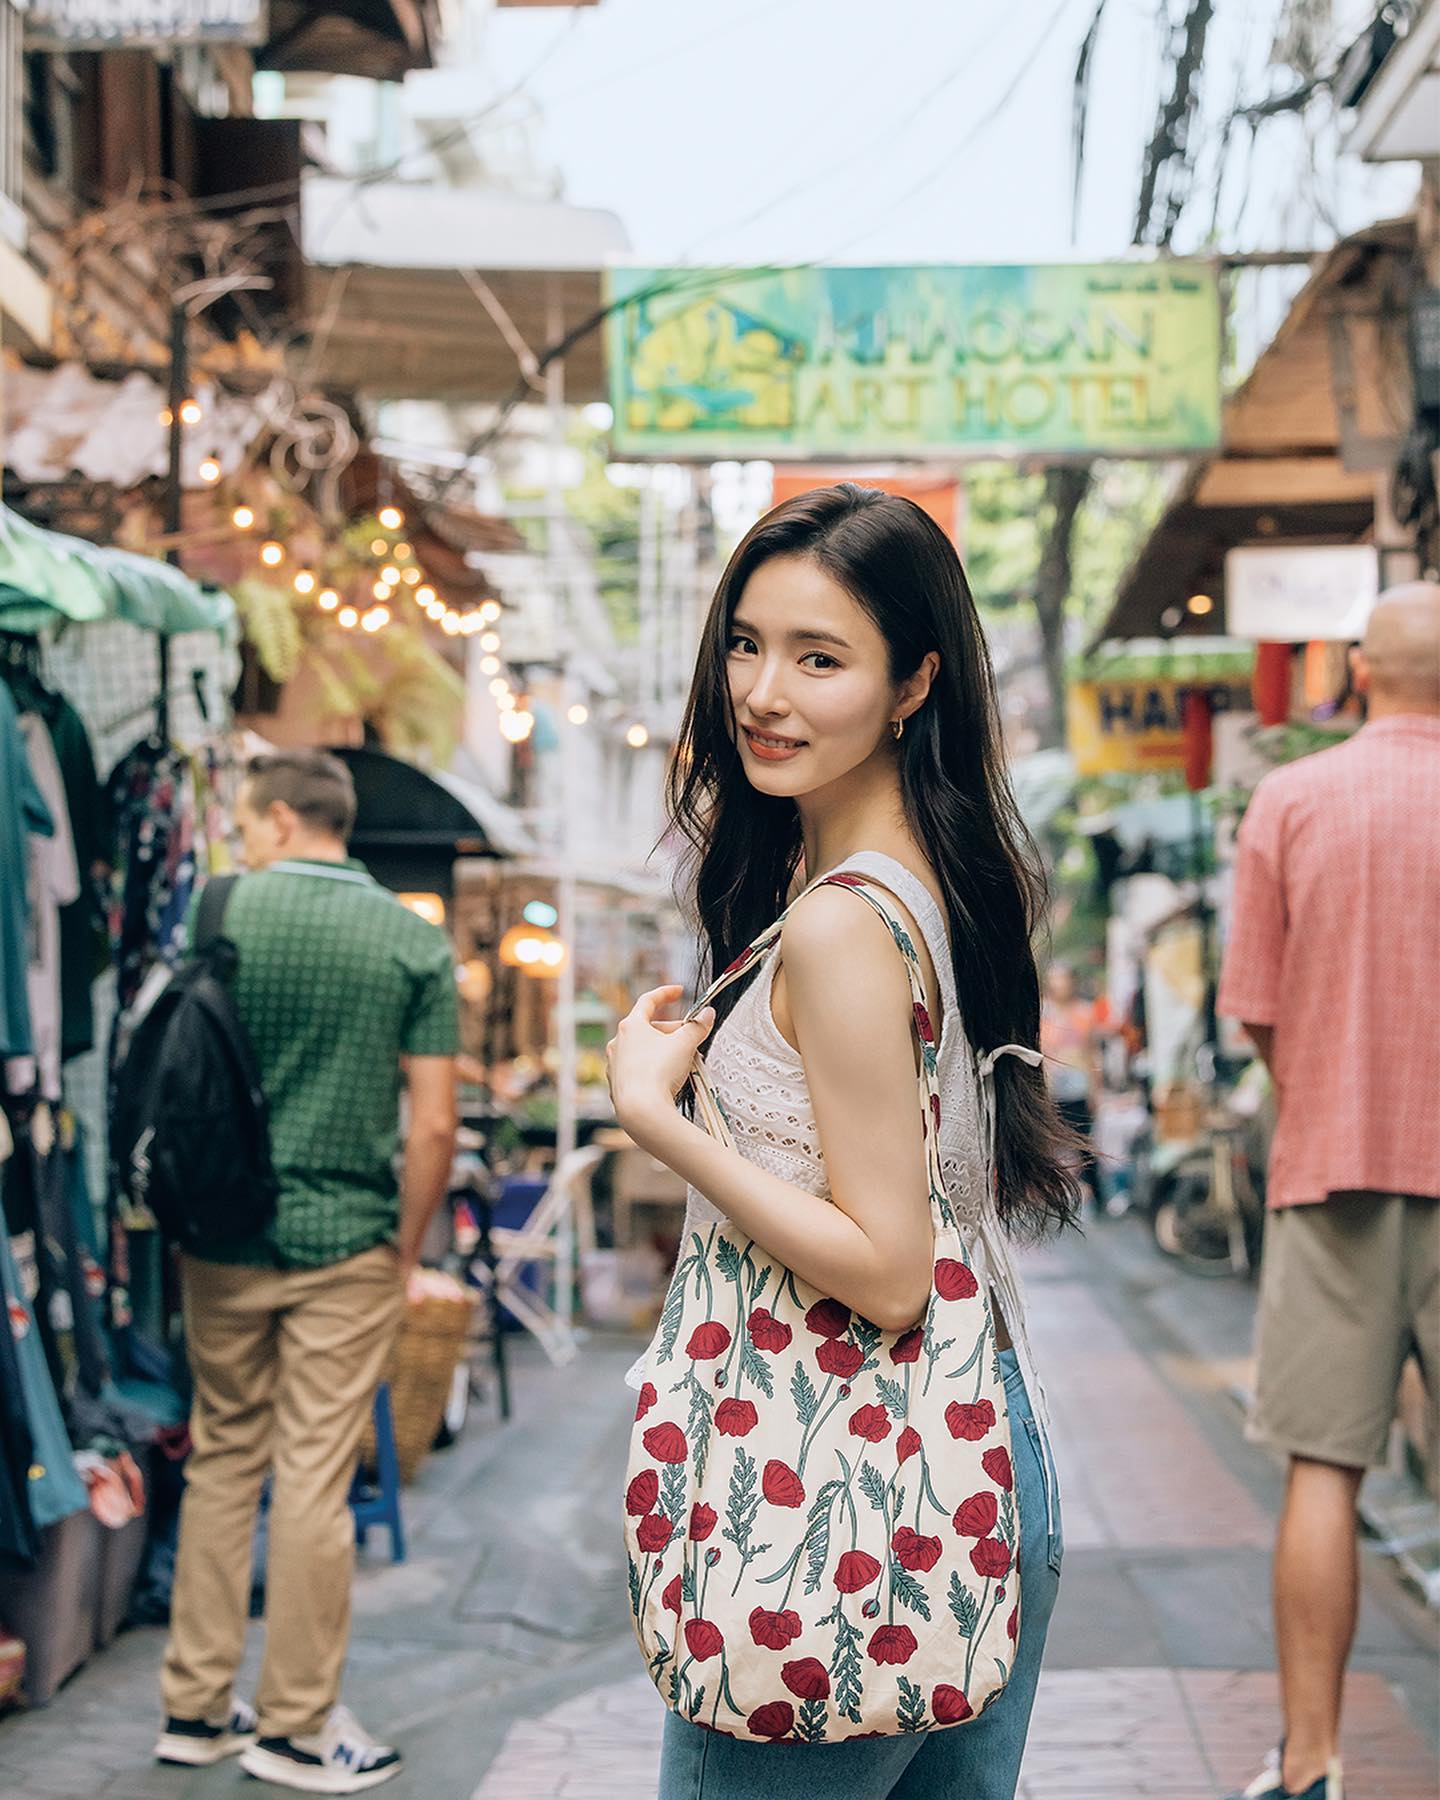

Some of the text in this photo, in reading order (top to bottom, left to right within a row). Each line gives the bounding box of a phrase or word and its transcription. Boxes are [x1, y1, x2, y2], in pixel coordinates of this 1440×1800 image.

[815, 309, 1154, 365] KHAOSAN
[801, 371, 1176, 432] ART HOTEL
